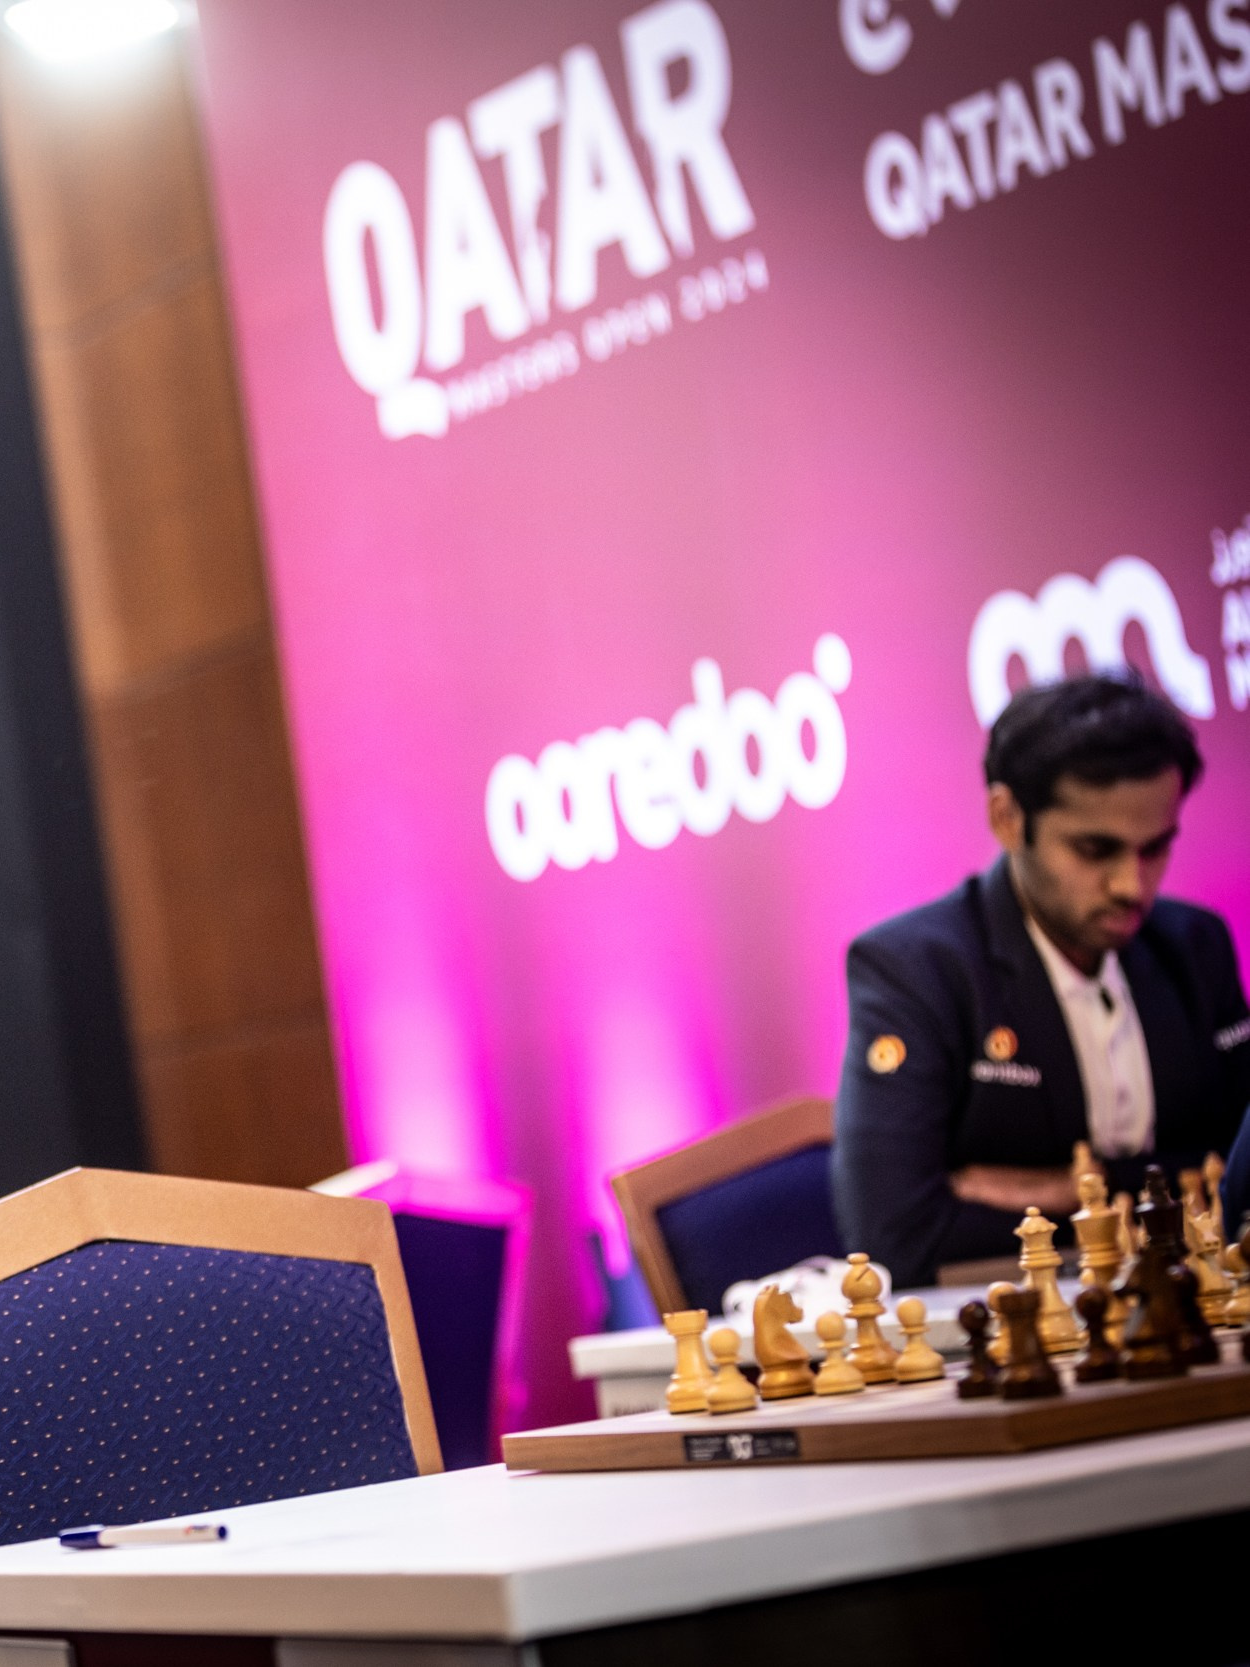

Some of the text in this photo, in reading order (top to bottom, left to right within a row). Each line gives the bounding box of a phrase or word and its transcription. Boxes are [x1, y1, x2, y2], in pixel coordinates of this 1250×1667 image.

[323, 0, 756, 440] QATAR
[864, 57, 1095, 240] QATAR
[1091, 0, 1250, 146] MAS
[583, 292, 672, 362] OPEN
[677, 248, 770, 322] 2024
